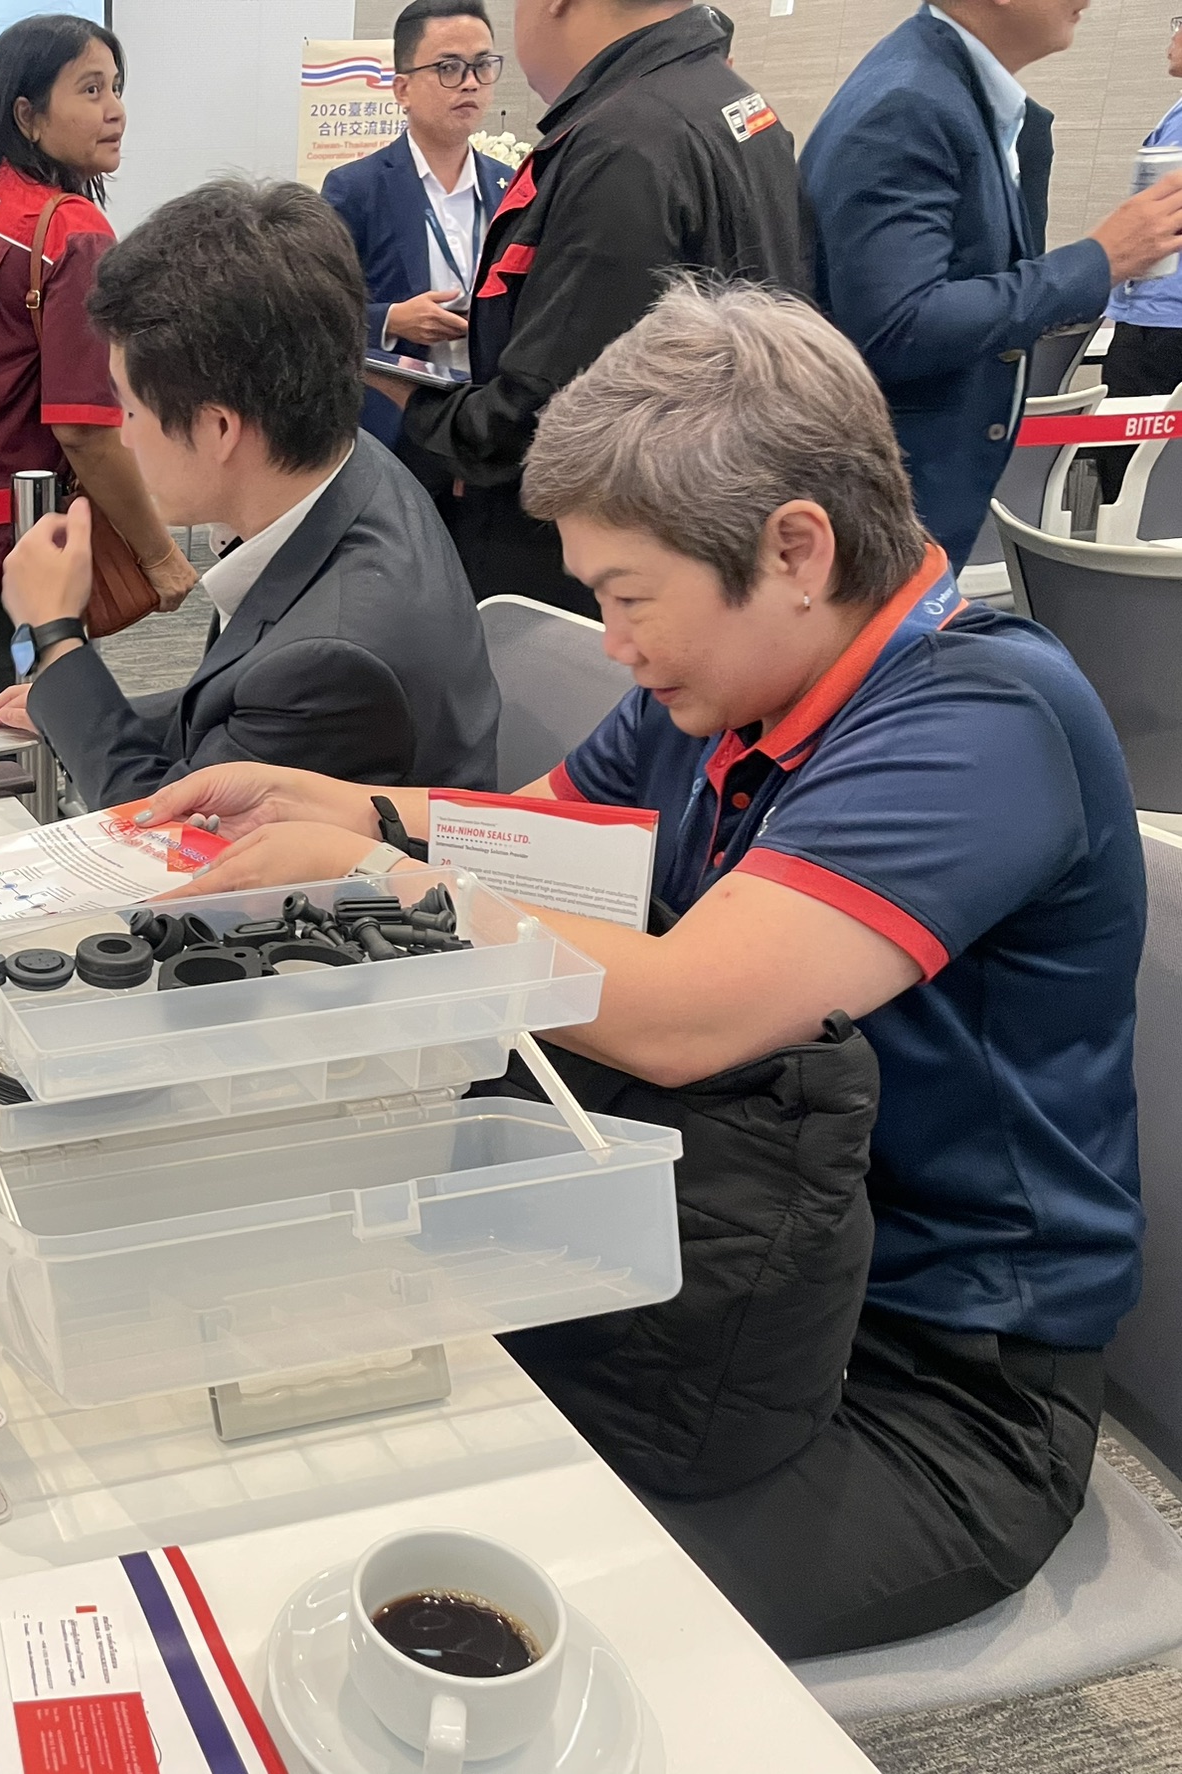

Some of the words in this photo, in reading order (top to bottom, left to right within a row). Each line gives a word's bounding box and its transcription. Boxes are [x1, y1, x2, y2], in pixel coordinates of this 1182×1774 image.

[1125, 415, 1176, 437] BITEC
[436, 824, 485, 838] THAI-NIHON
[487, 830, 511, 842] SEALS
[513, 834, 531, 844] LTD.
[465, 845, 489, 853] Technology
